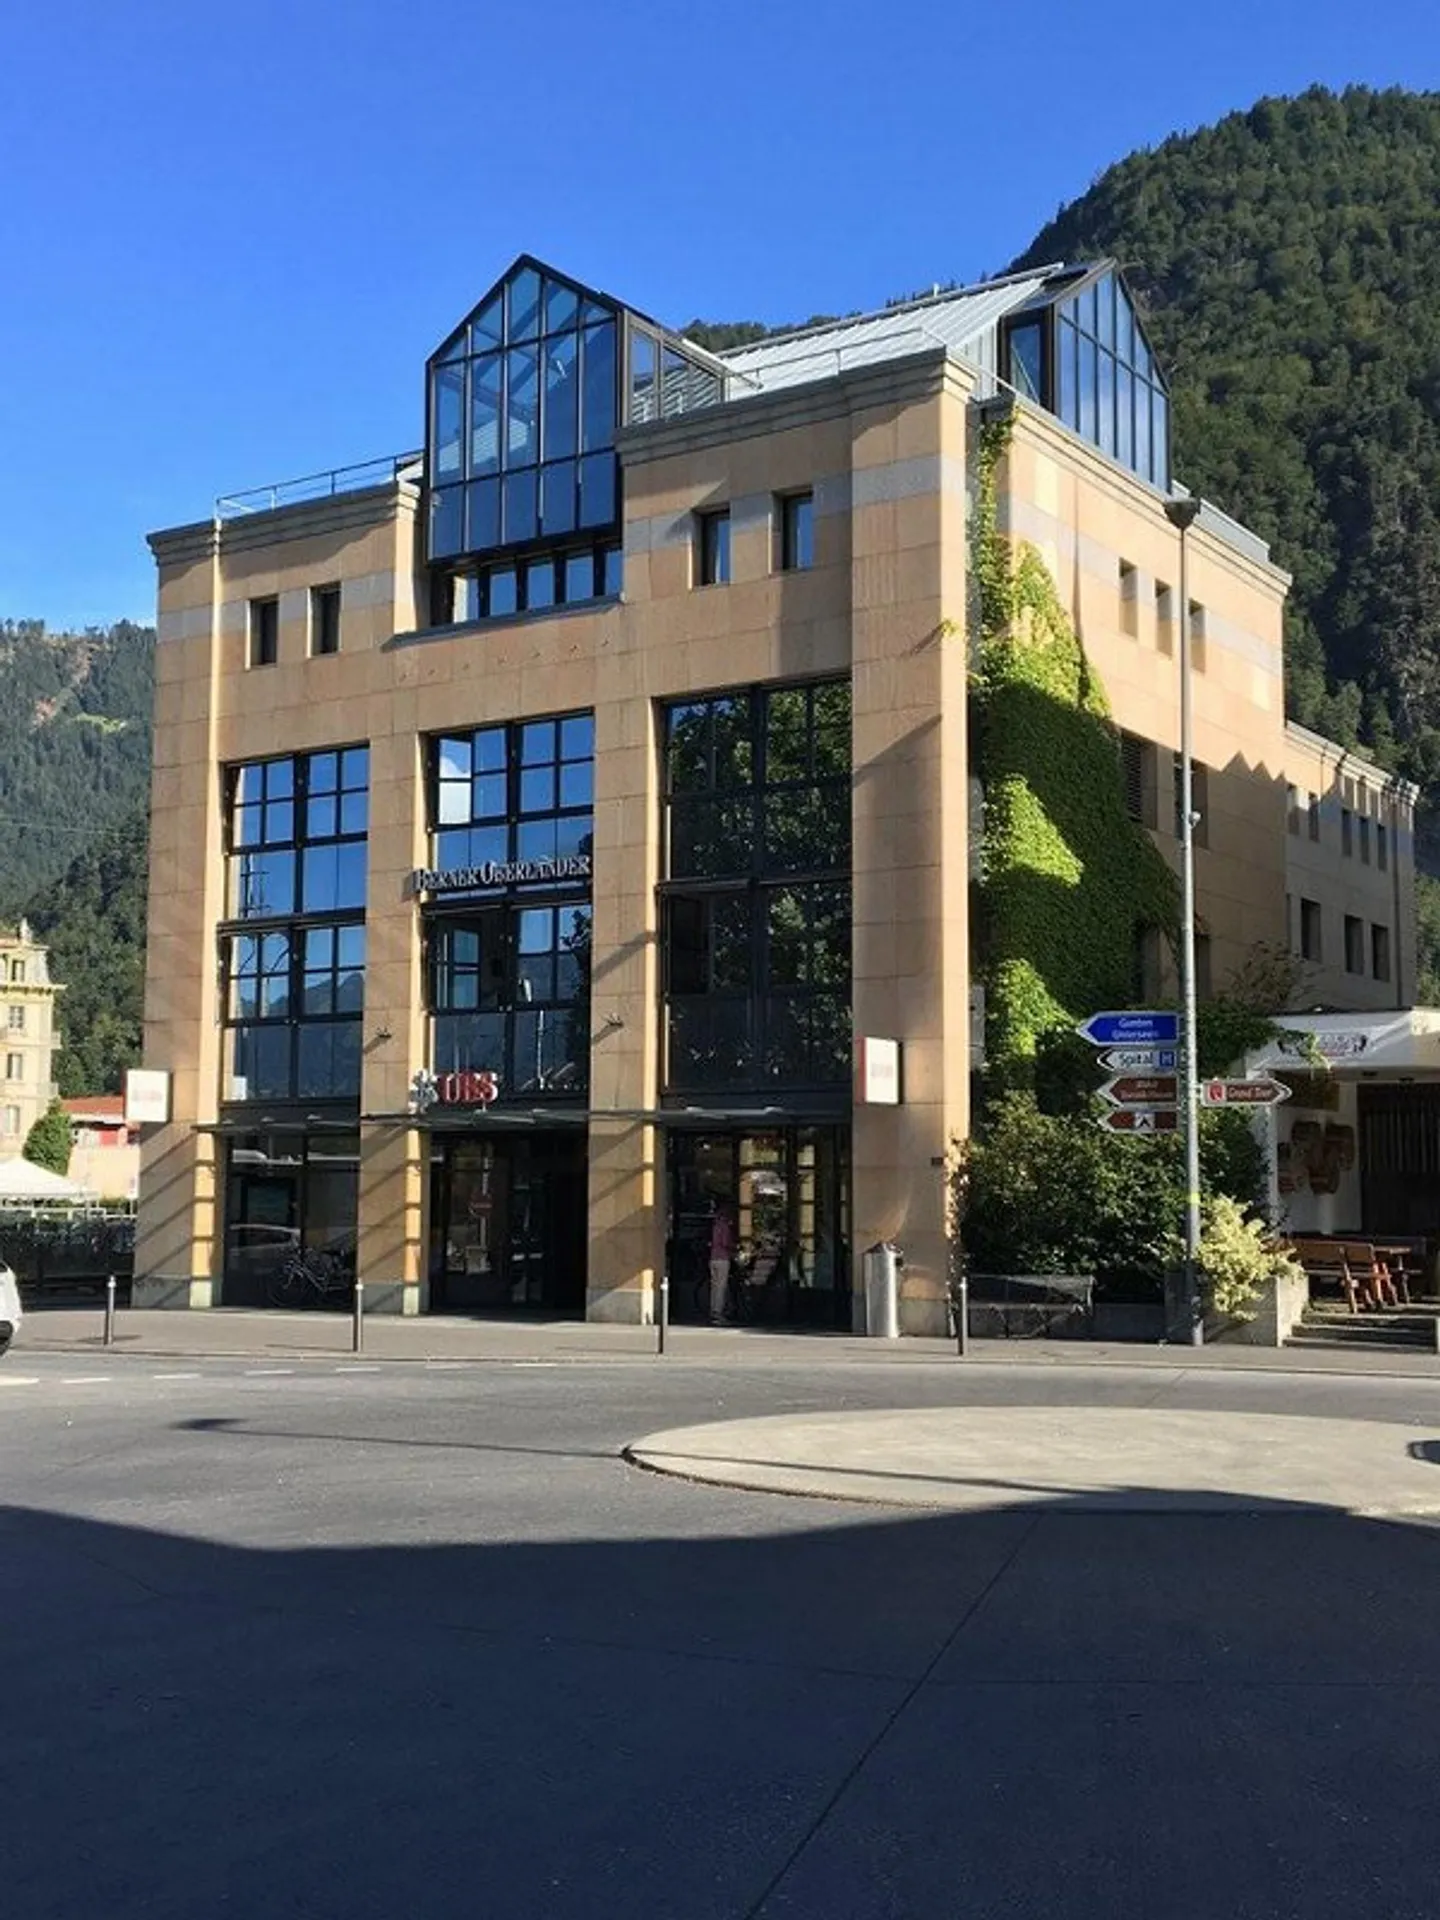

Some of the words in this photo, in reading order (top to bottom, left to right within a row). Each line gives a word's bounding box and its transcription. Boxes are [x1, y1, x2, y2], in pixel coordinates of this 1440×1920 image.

[416, 866, 478, 890] BERNER
[1118, 1052, 1153, 1067] Spital
[439, 1071, 499, 1103] UBS
